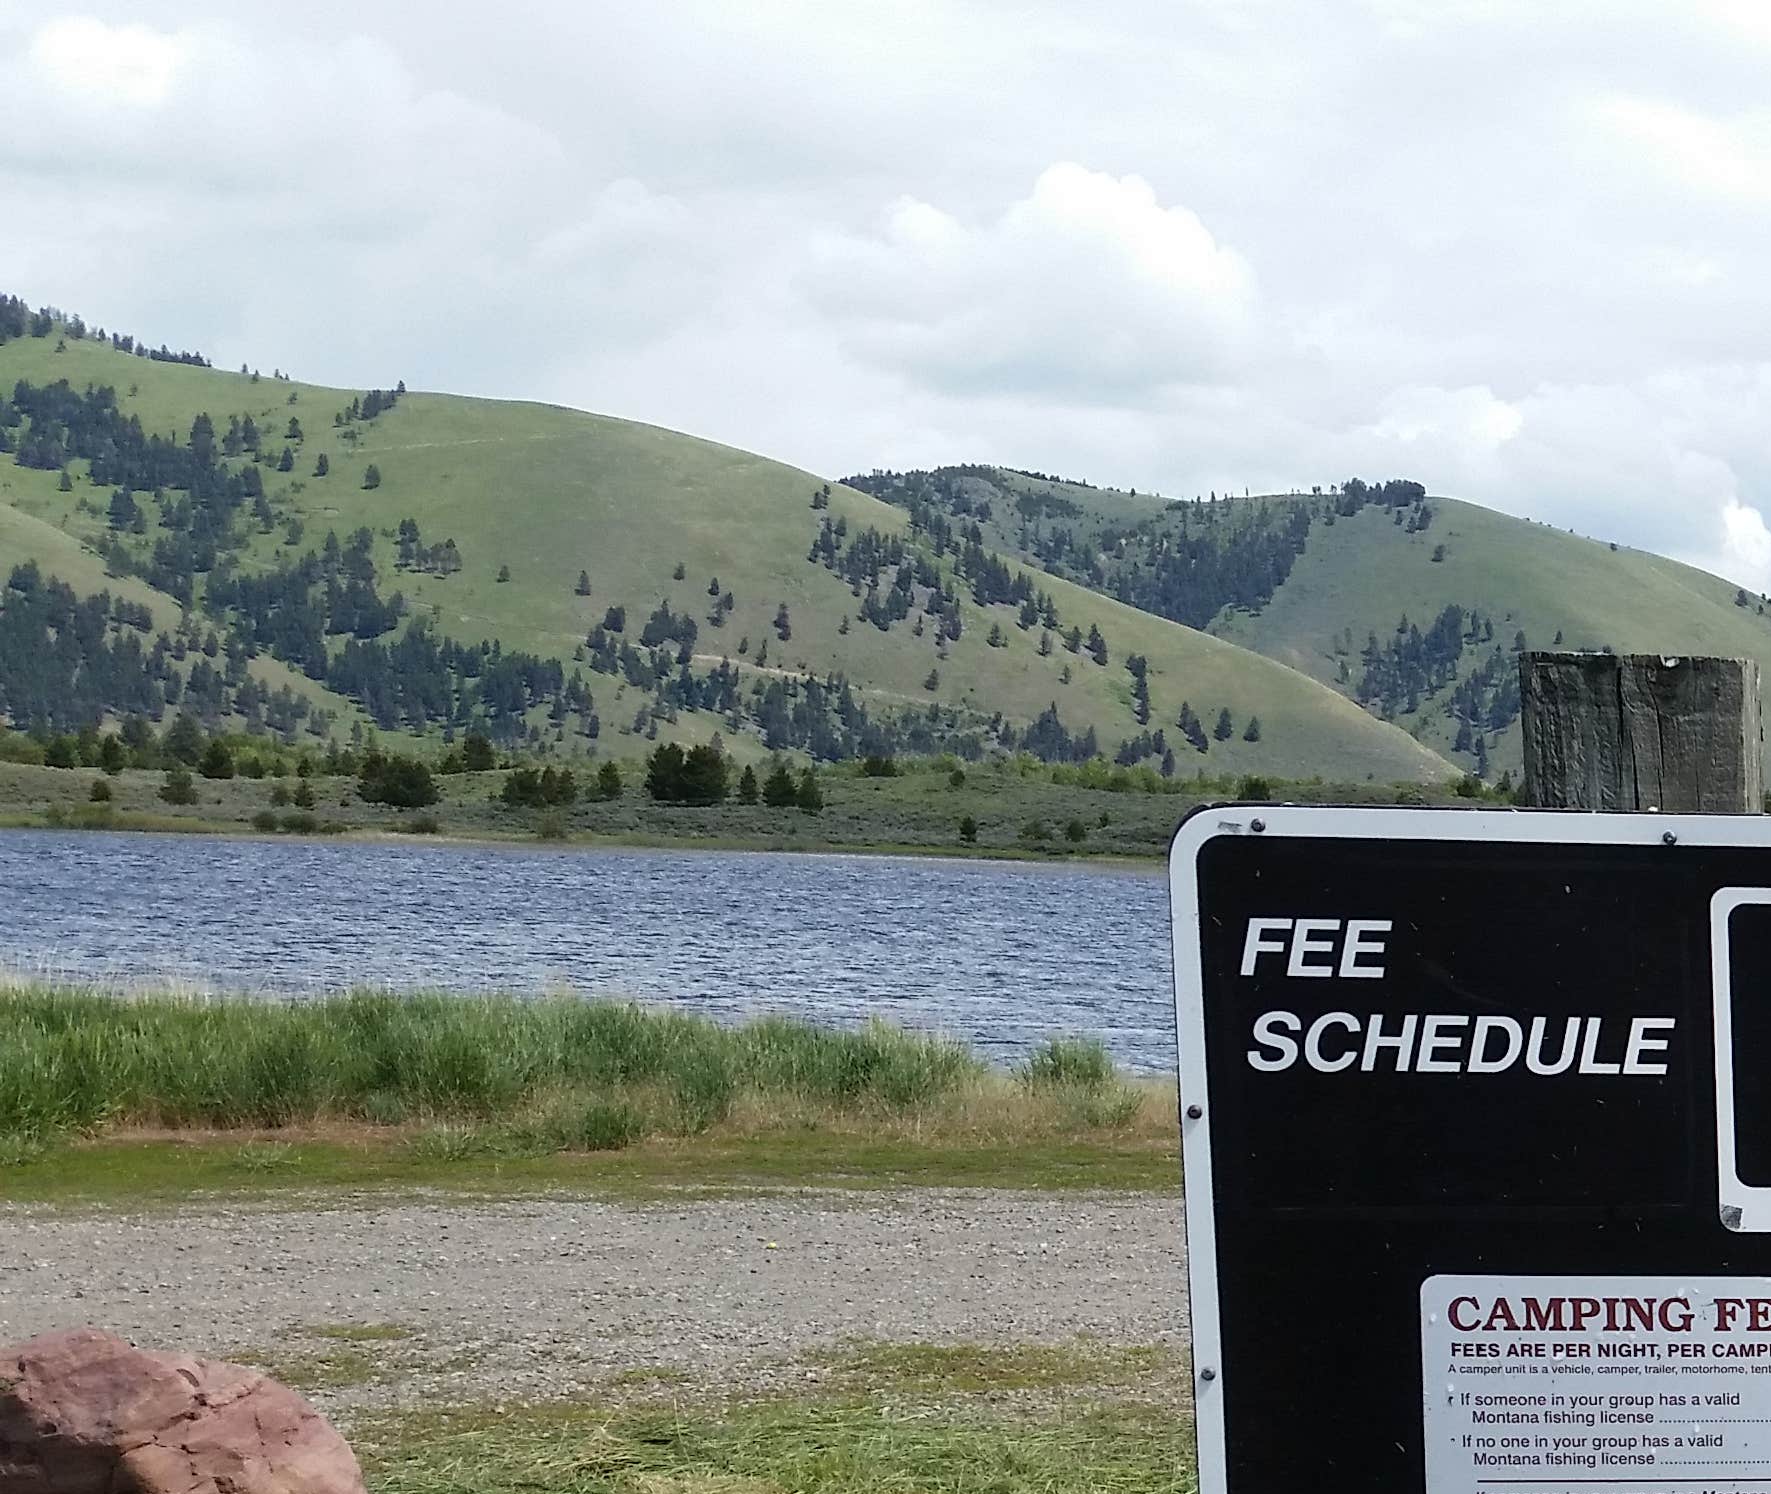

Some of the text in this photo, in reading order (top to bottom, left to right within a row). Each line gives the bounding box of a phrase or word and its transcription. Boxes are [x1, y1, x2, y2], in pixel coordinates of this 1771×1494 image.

[1240, 917, 1392, 978] FEE
[1246, 1010, 1676, 1076] SCHEDULE
[1447, 1296, 1695, 1332] CAMPING
[1450, 1342, 1501, 1358] FEES
[1505, 1343, 1547, 1358] ARE
[1552, 1343, 1592, 1358] PER
[1597, 1343, 1662, 1361] NIGHT,
[1667, 1343, 1706, 1358] PER
[1447, 1363, 1457, 1374] A
[1459, 1363, 1503, 1377] camper
[1504, 1364, 1527, 1377] unit
[1528, 1364, 1539, 1375] is
[1541, 1366, 1550, 1374] a
[1551, 1363, 1595, 1376] vehicle,
[1597, 1366, 1642, 1377] camper,
[1644, 1364, 1678, 1376] trailer,
[1680, 1364, 1748, 1376] motorhome,
[1750, 1364, 1771, 1375] tent
[1460, 1392, 1740, 1410] If someone in your group has a valid
[1472, 1410, 1540, 1424] Montana
[1542, 1410, 1595, 1427] fishing
[1600, 1410, 1654, 1424] license
[1462, 1433, 1723, 1451] If no one in your group has a valid
[1473, 1452, 1542, 1466] Montana
[1544, 1451, 1596, 1469] fishing
[1601, 1451, 1655, 1465] license
